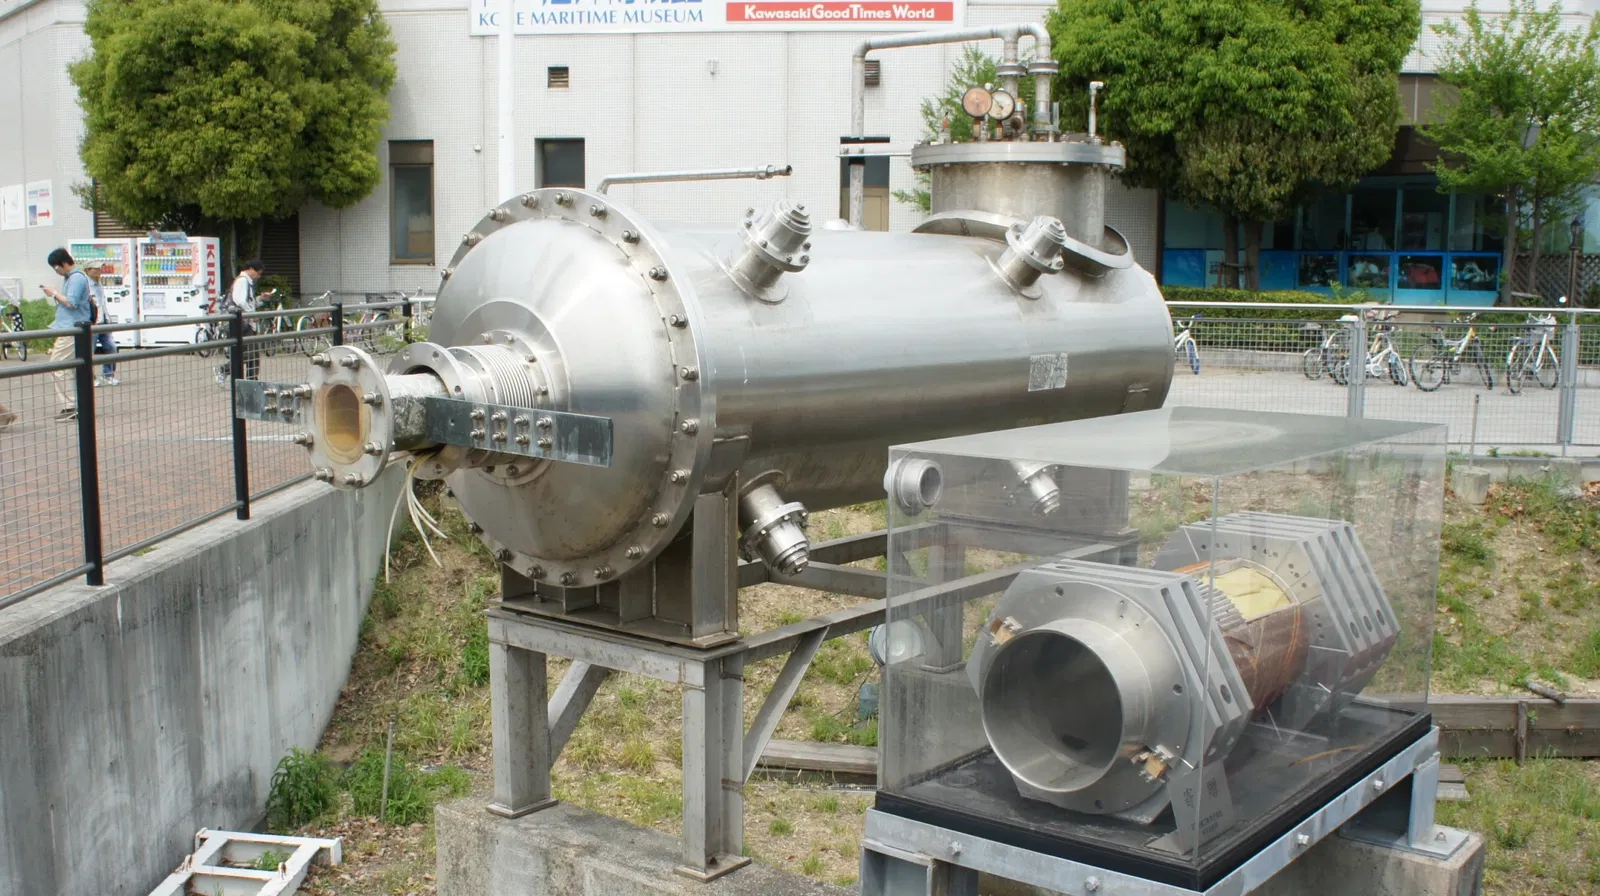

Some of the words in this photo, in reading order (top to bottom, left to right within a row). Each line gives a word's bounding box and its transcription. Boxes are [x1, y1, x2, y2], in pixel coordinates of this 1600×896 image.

[530, 11, 617, 25] MARITIME
[623, 9, 704, 23] MUSEUM
[892, 5, 935, 19] World
[206, 244, 217, 314] KIRIN
